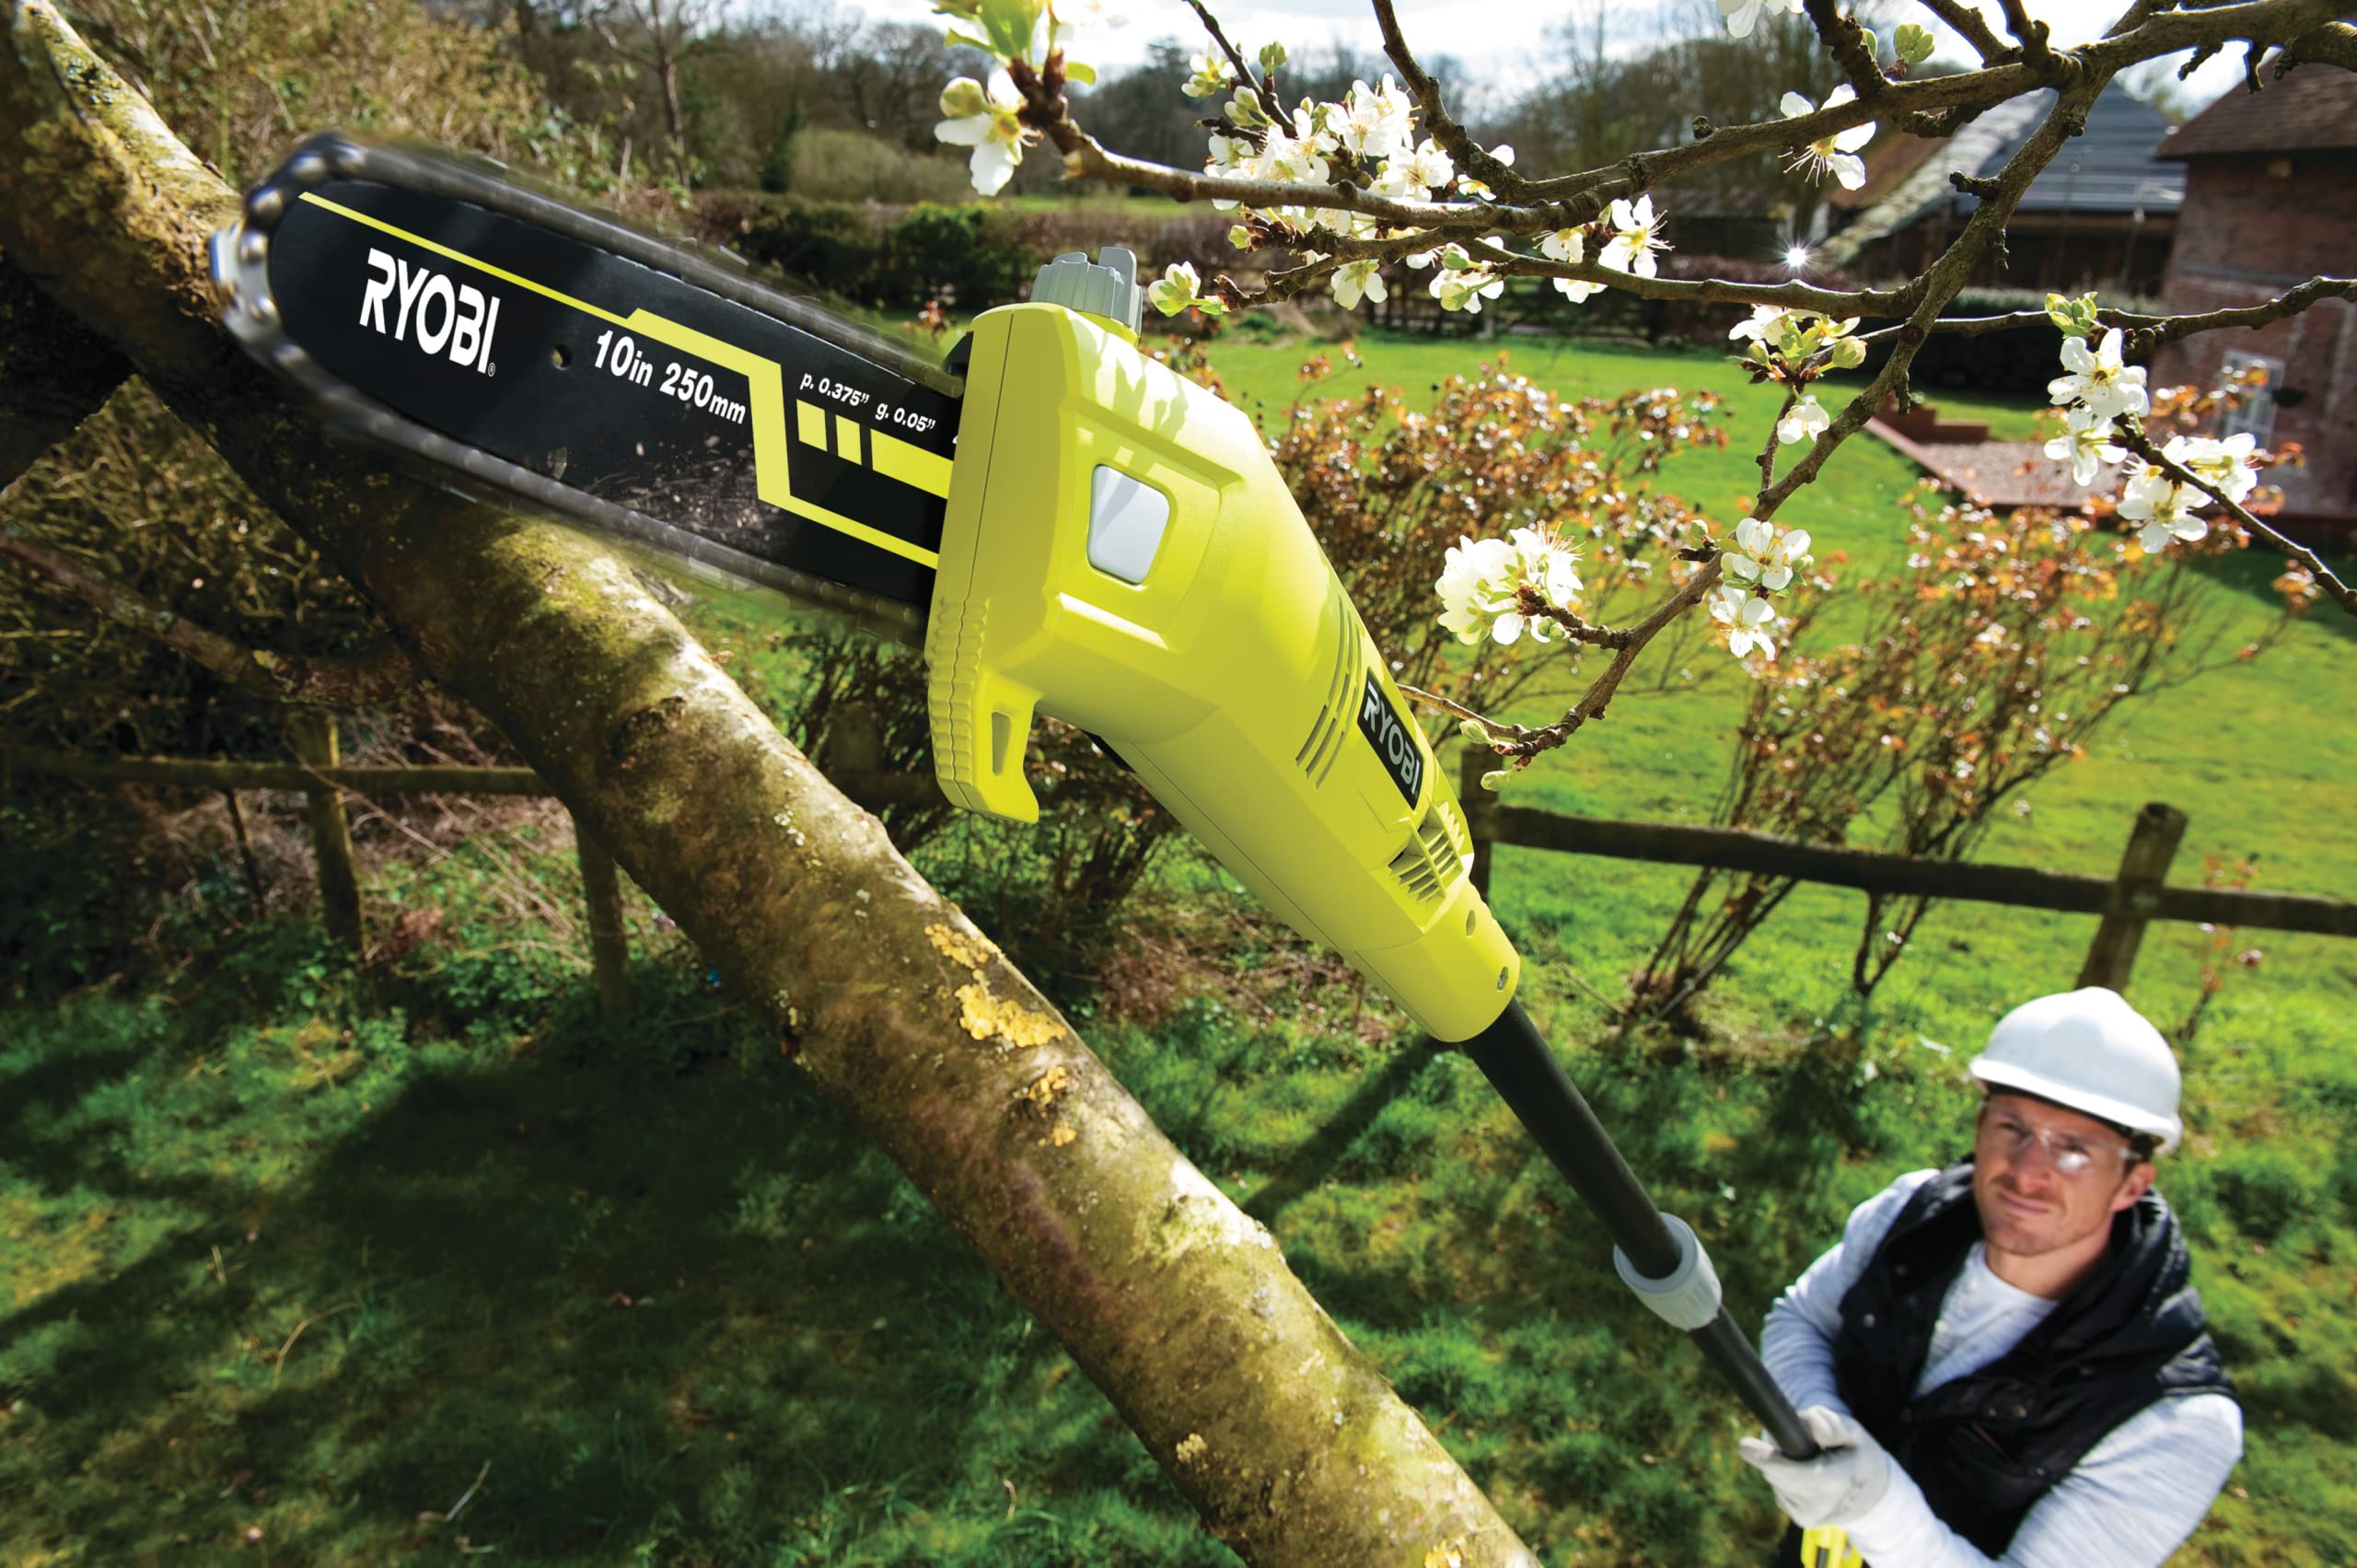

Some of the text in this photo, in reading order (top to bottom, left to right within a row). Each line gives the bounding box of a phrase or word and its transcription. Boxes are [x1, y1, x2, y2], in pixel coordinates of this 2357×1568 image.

[359, 248, 501, 374] RYOBI
[595, 330, 746, 424] 10in 250mm
[799, 373, 814, 389] p.
[875, 402, 889, 420] g.
[1364, 681, 1421, 795] RYOBI
